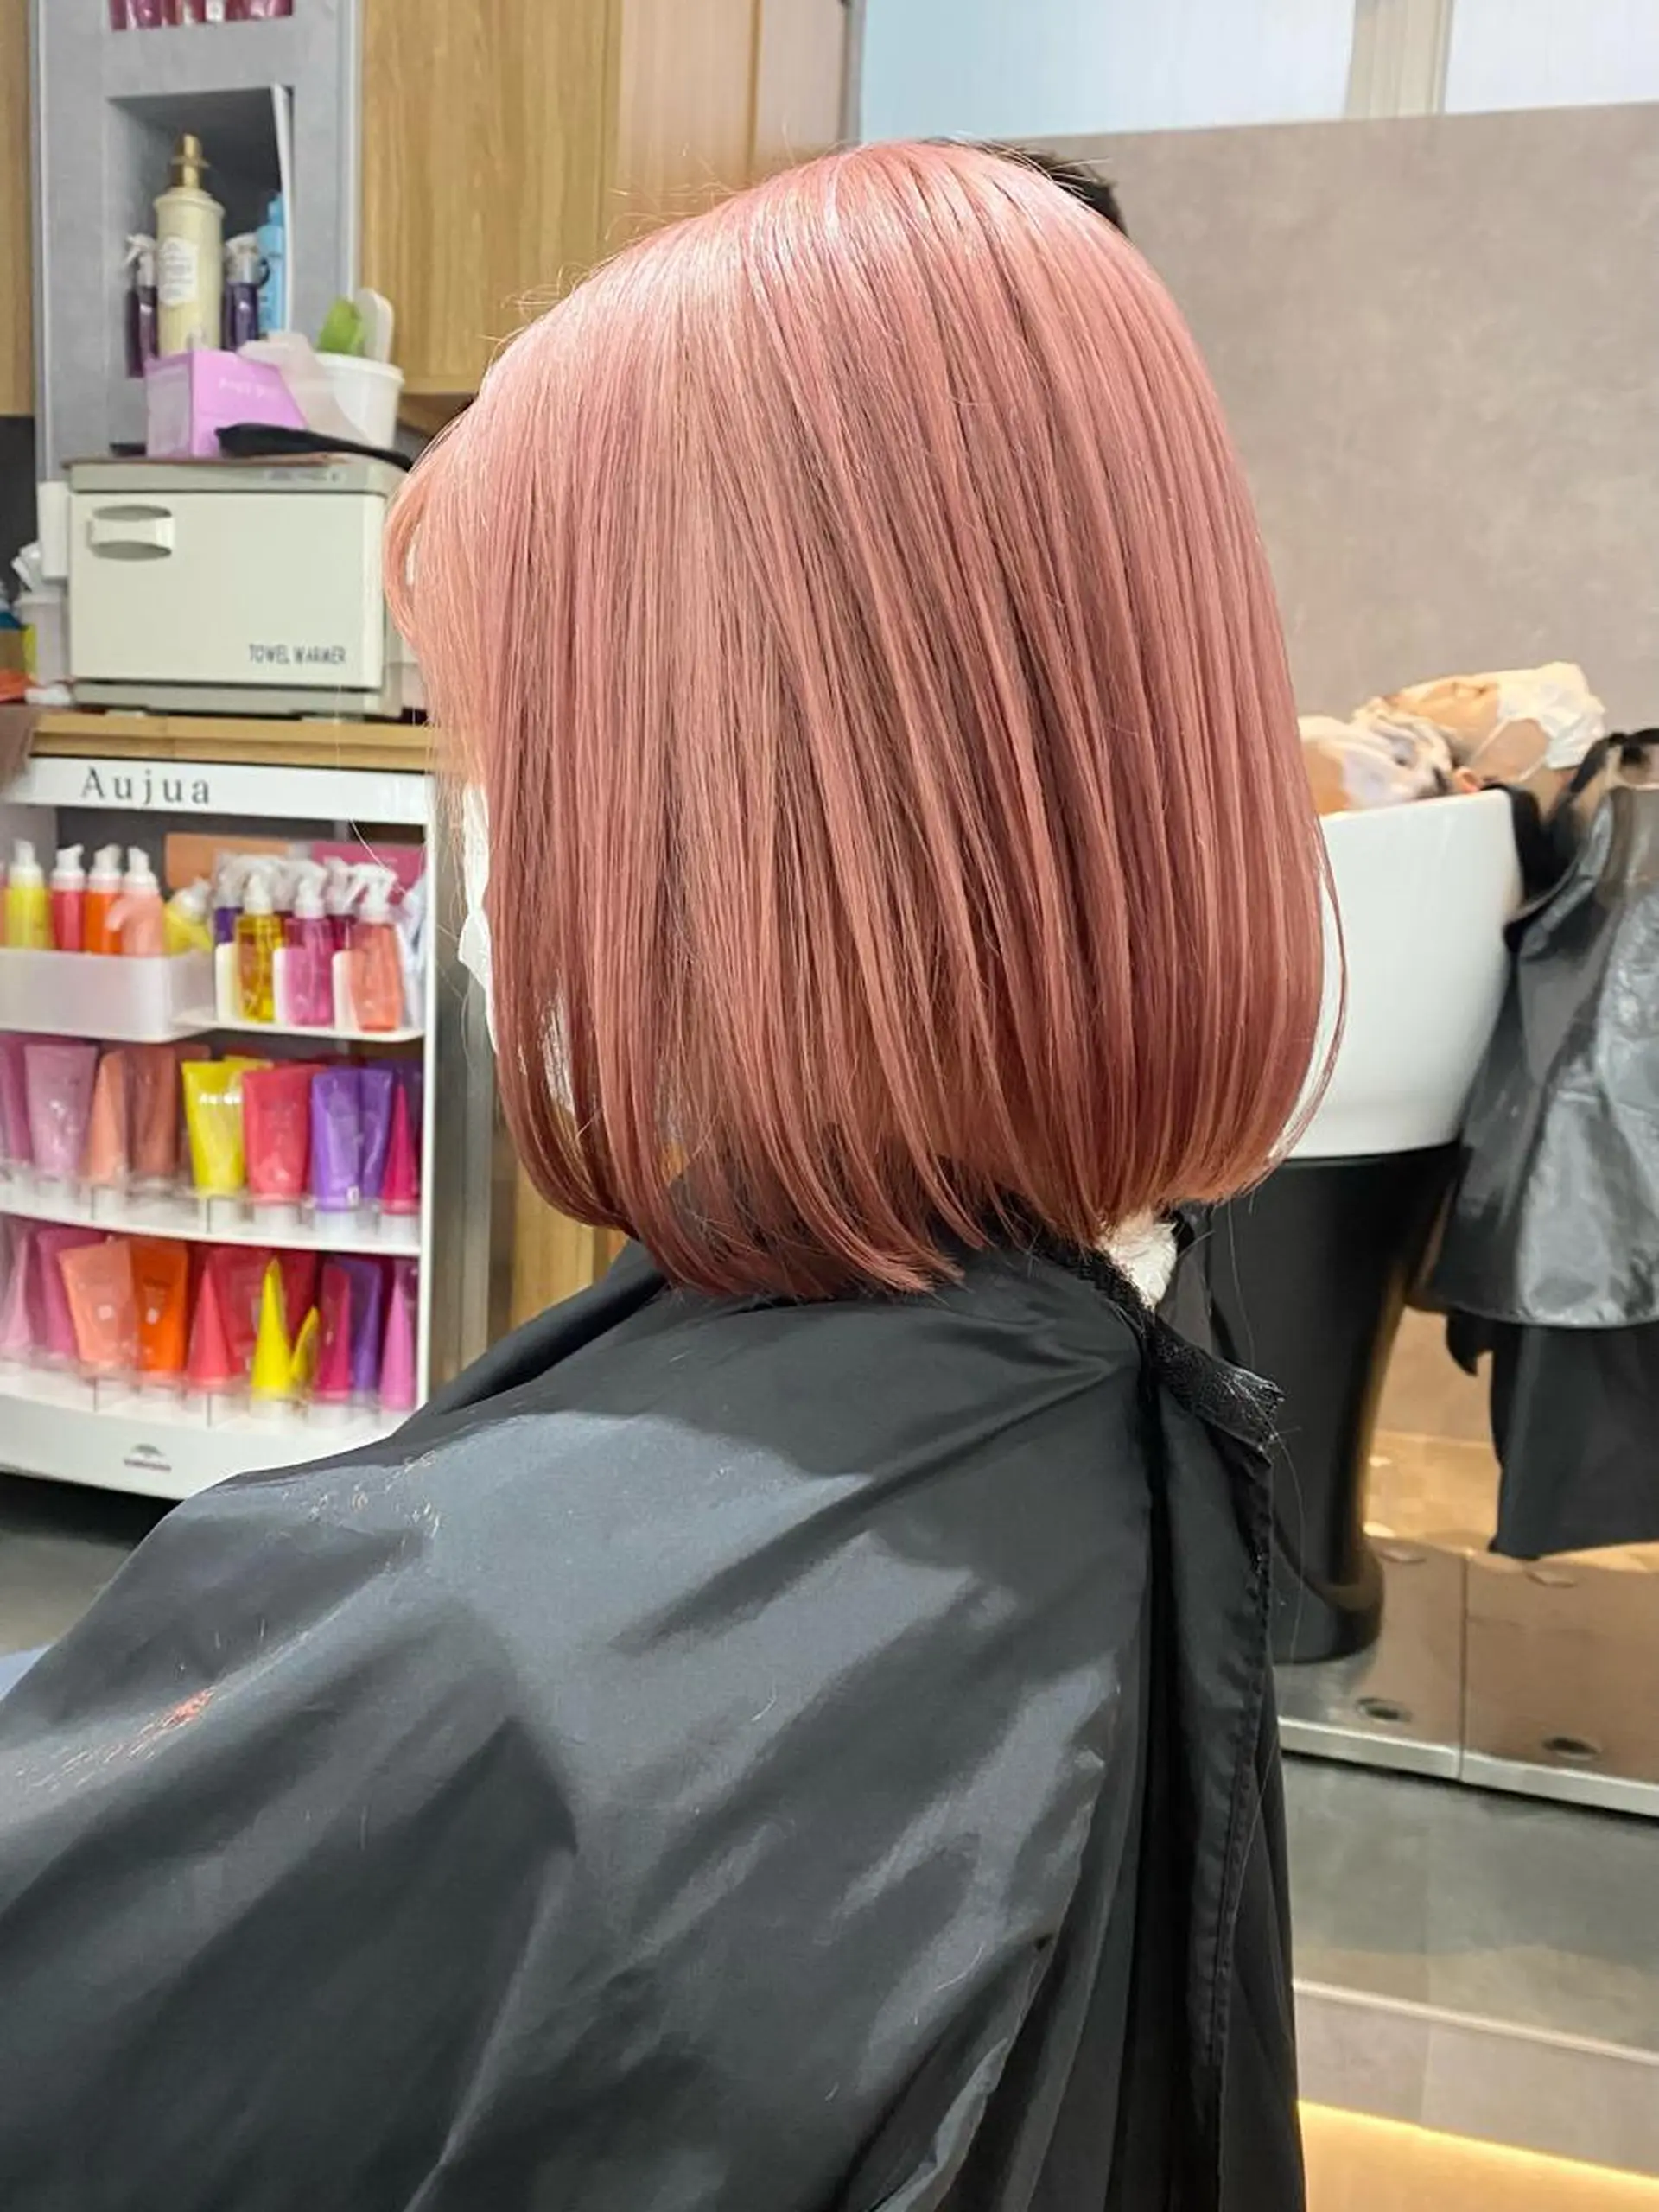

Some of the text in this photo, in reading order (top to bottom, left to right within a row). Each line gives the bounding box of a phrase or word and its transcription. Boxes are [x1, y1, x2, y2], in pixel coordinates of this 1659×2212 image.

[248, 643, 346, 664] TOWEL WARMER
[81, 766, 210, 805] Aujua
